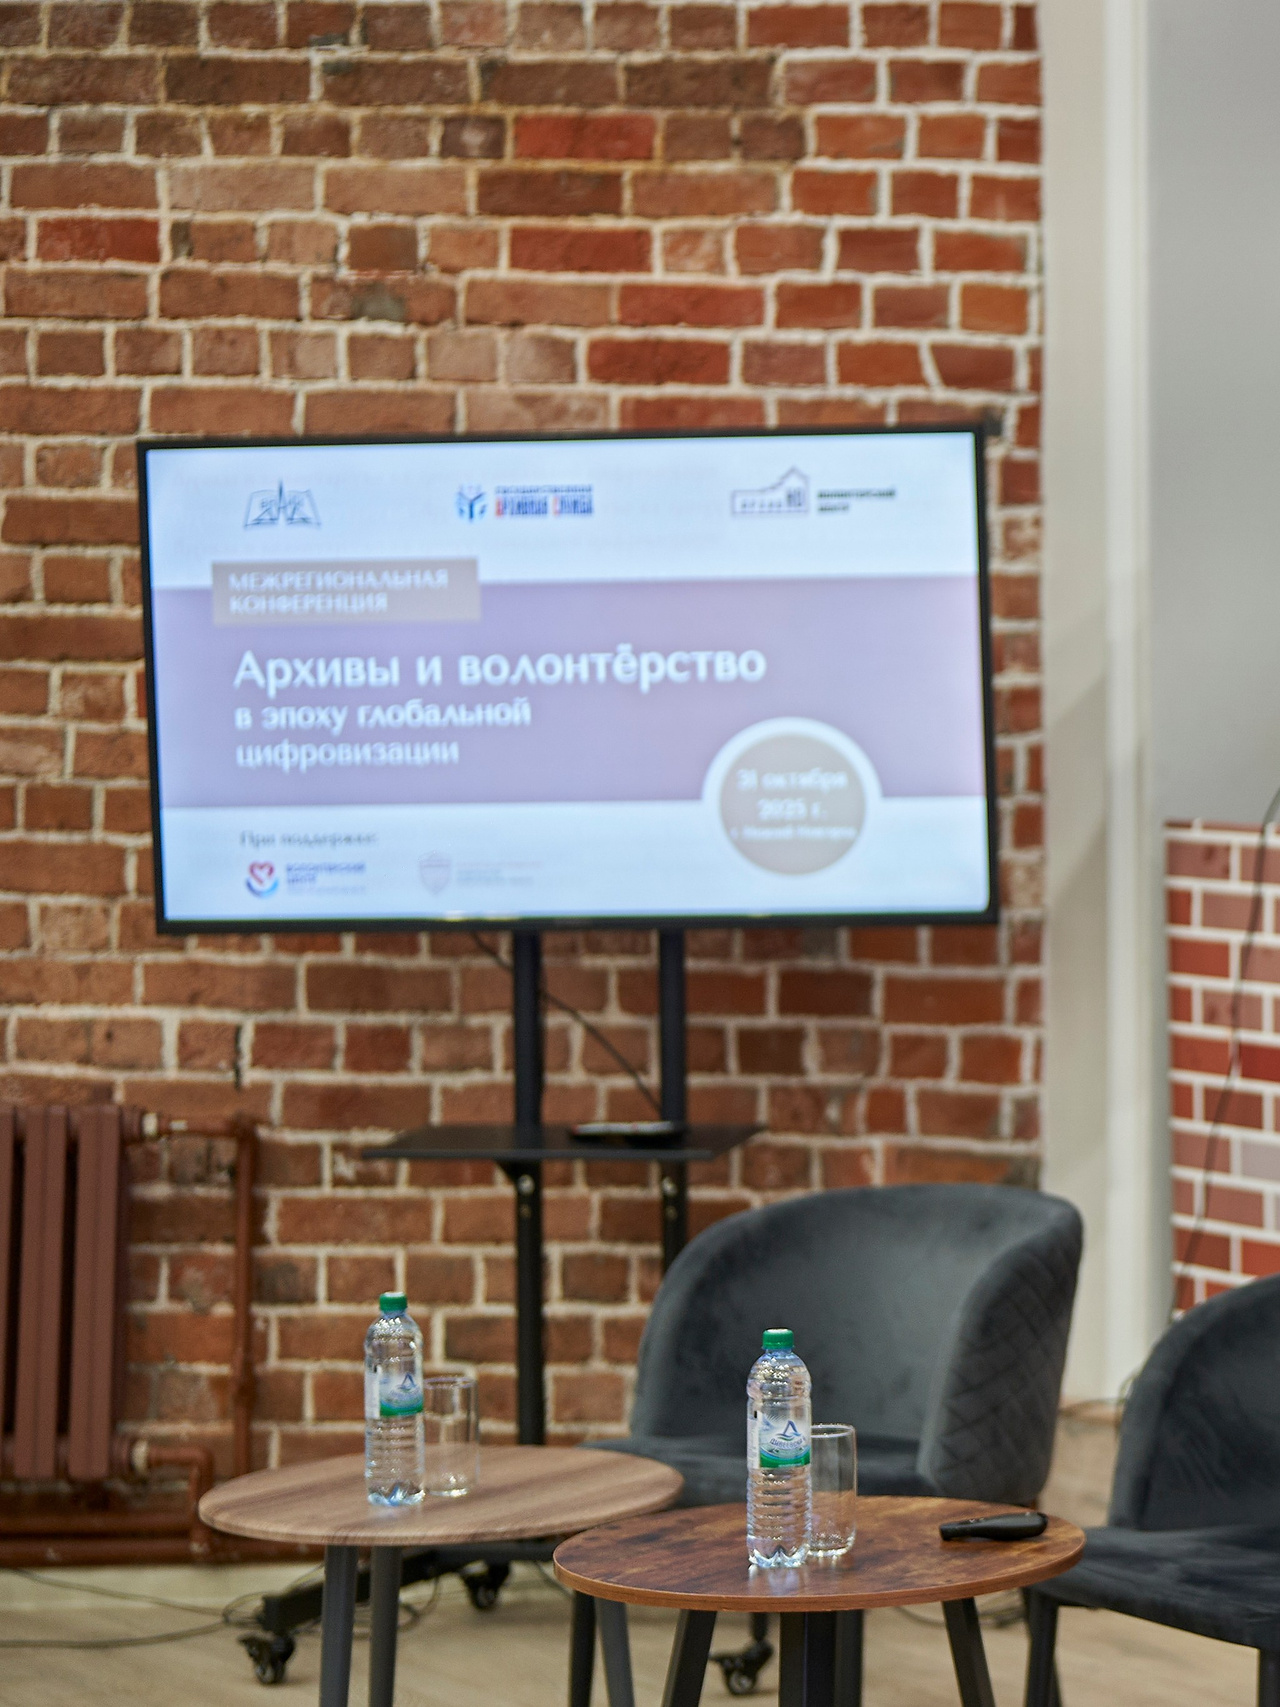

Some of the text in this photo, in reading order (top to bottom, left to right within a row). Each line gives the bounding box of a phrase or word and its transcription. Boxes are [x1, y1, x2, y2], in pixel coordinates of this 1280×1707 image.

[228, 568, 449, 592] МЕЖРЕГИОНАЛЬНАЯ
[229, 591, 389, 615] КОНФЕРЕНЦИЯ
[233, 643, 768, 700] Архивы и волонтёрство
[234, 697, 532, 737] в эпоху глобальной
[235, 738, 460, 773] цифровизации
[761, 767, 848, 794] октября
